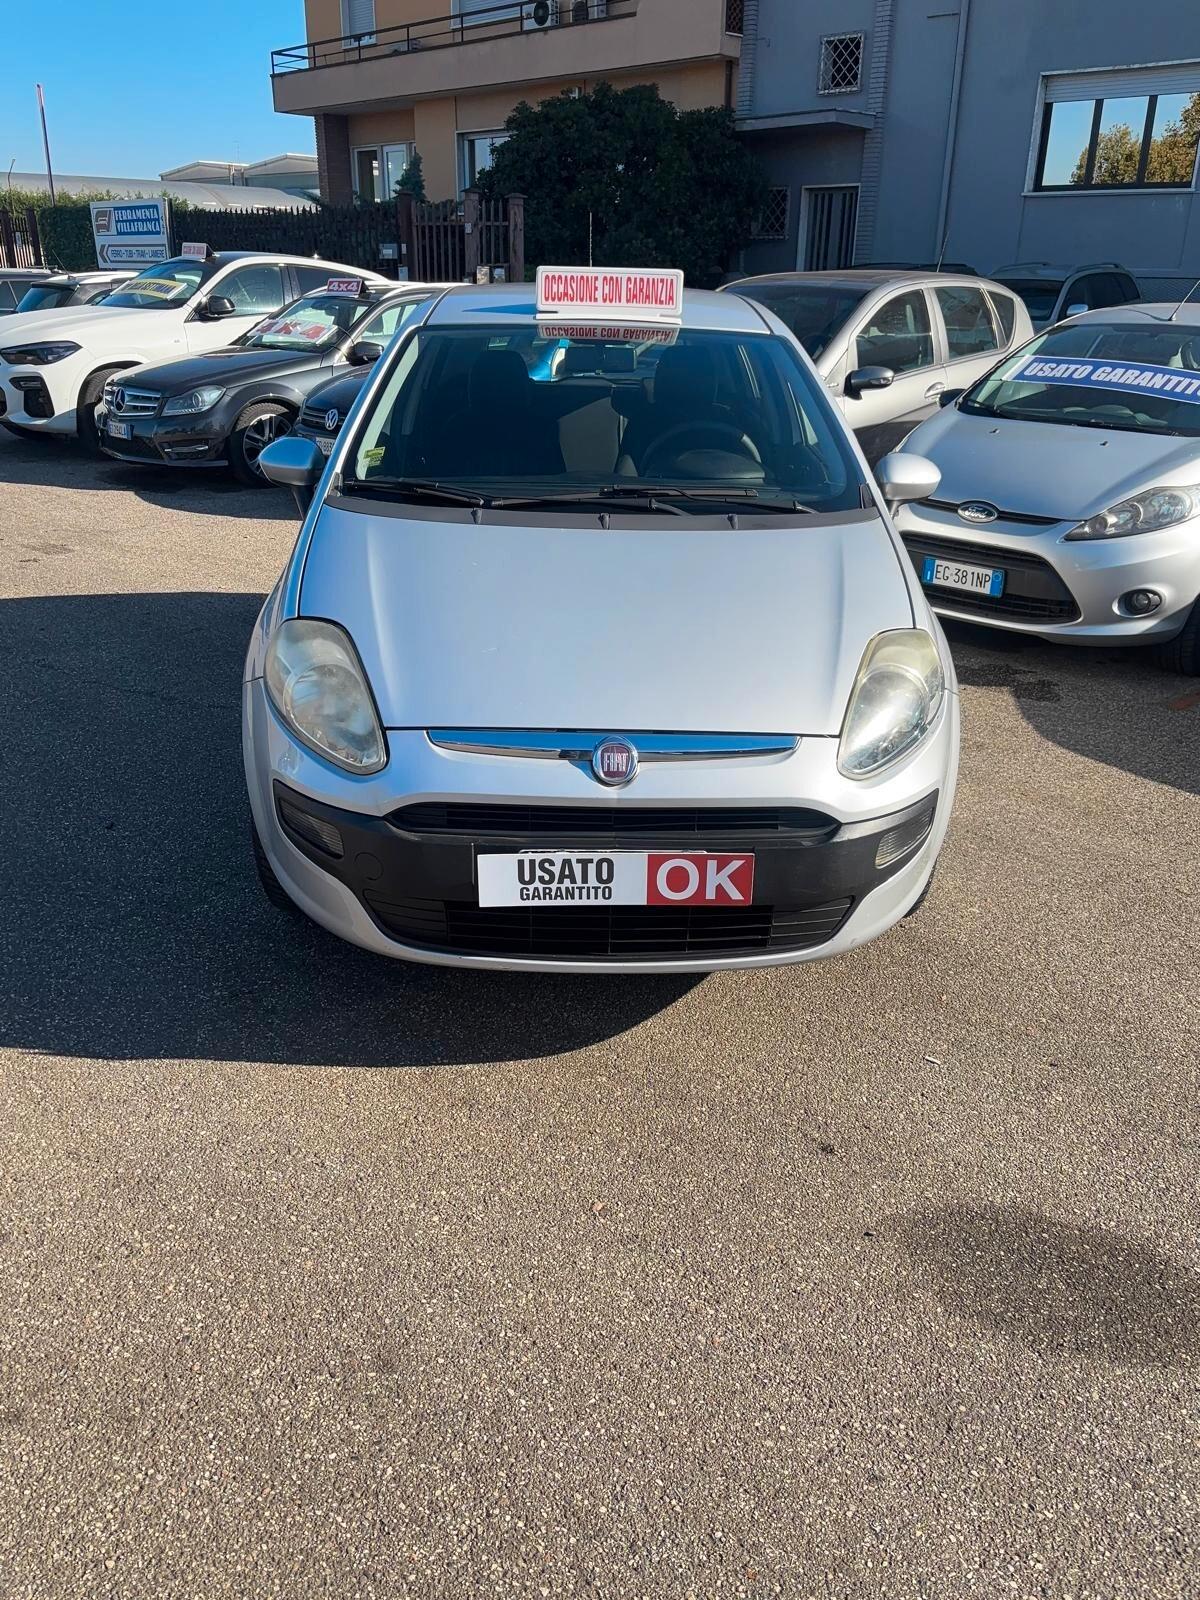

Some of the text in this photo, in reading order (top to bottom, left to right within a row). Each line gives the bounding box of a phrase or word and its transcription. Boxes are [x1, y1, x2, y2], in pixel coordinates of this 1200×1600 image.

[114, 208, 158, 221] FERRAMENTA
[117, 221, 160, 232] VILLAFRANCA
[329, 281, 358, 292] 4x4
[544, 274, 674, 306] OCCASIONE CON GARANZIA
[1023, 362, 1200, 396] USATO GARANTIT
[603, 752, 629, 772] FIAT
[517, 858, 615, 885] USATO
[656, 858, 746, 900] OK
[519, 885, 613, 901] GARANTITO
